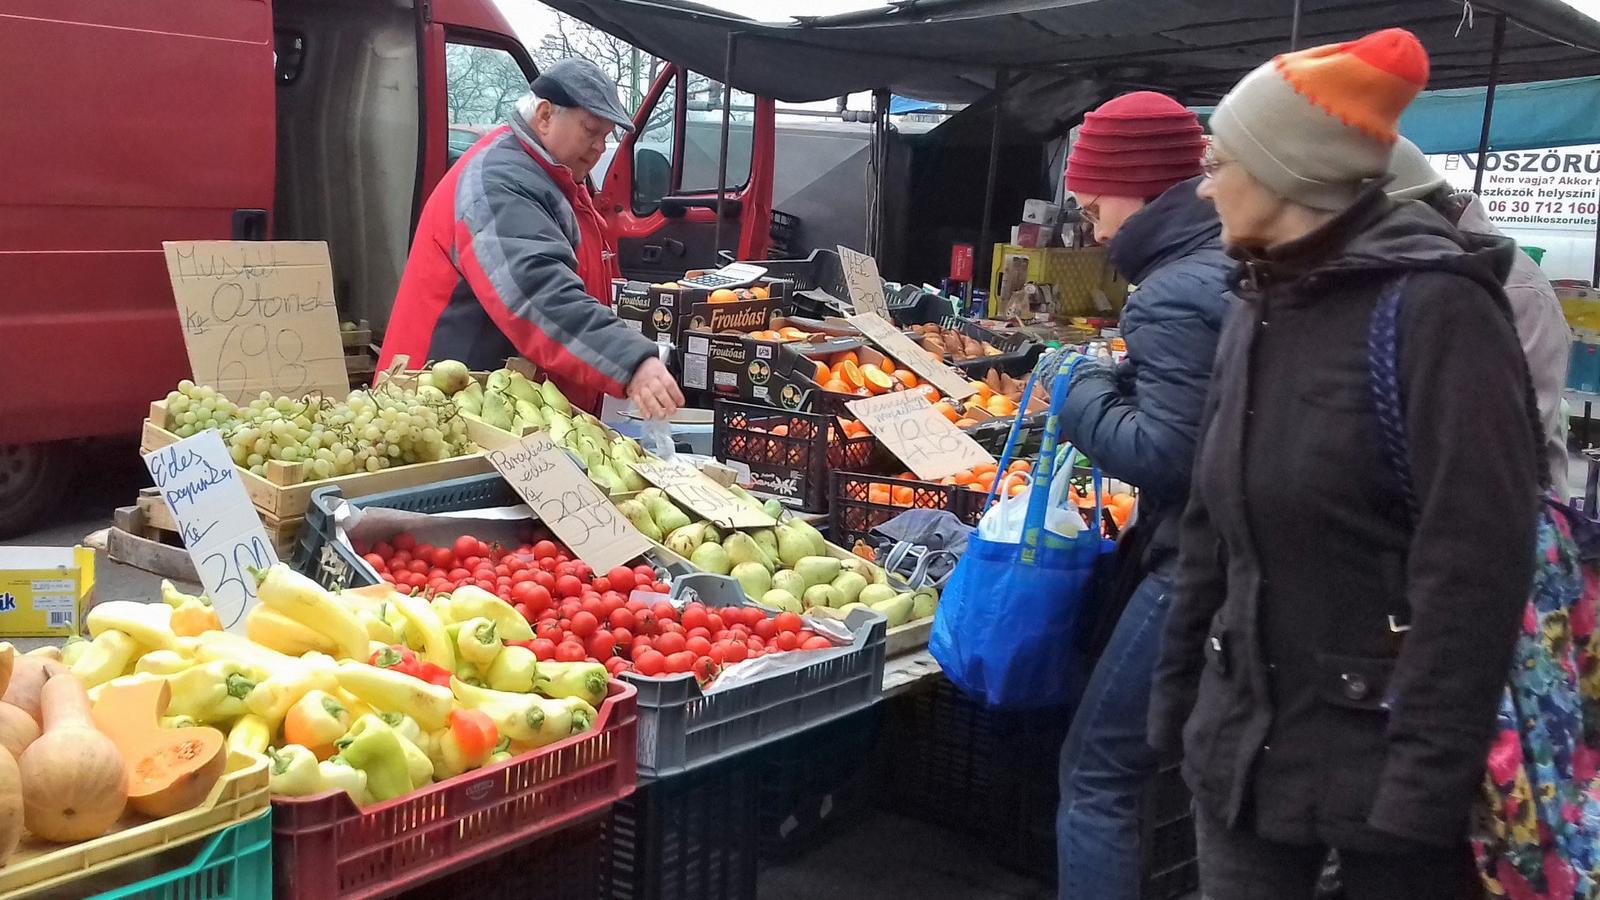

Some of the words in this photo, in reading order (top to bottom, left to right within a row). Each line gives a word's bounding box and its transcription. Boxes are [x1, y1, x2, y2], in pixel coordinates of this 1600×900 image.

[1490, 175, 1514, 184] Nem
[1519, 176, 1555, 186] vagja?
[1558, 176, 1592, 186] Akkor
[1488, 201, 1507, 212] 06
[1511, 202, 1530, 213] 30
[1535, 201, 1563, 213] 712
[1568, 202, 1600, 215] 160
